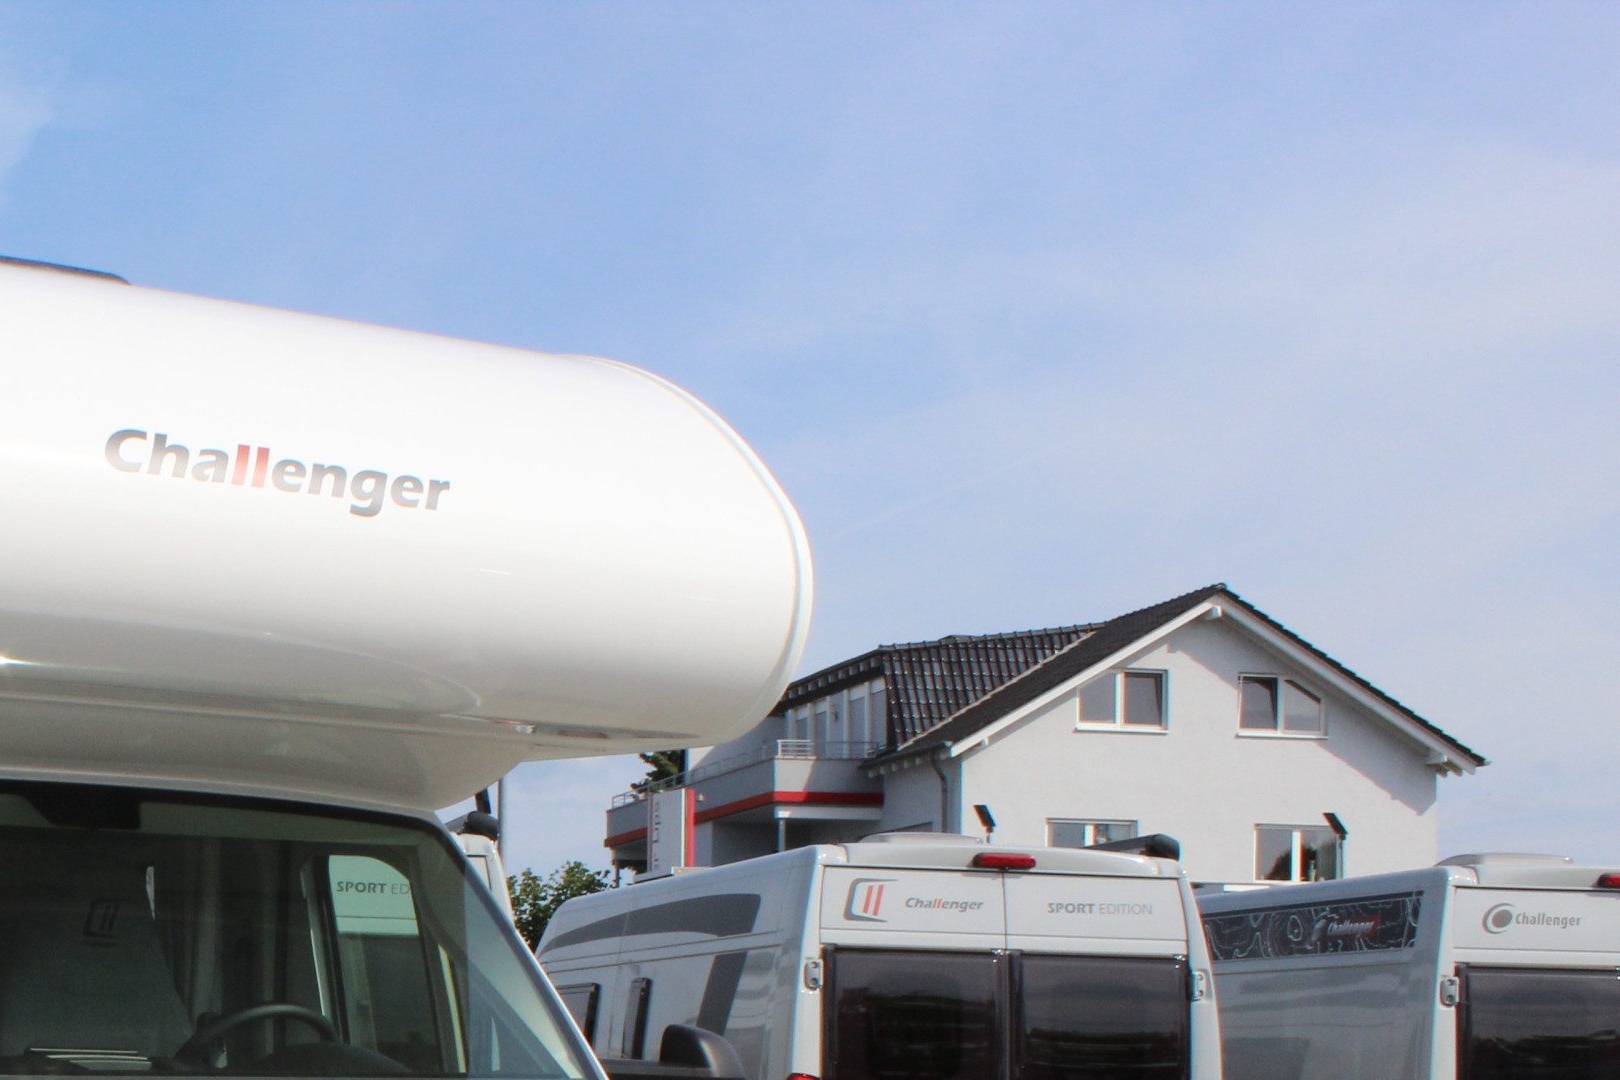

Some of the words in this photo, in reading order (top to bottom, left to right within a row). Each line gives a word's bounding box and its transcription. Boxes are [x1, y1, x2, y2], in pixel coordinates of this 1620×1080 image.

[103, 427, 451, 518] Challenger
[336, 880, 387, 894] SPORT
[905, 896, 984, 913] Challenger
[1047, 901, 1096, 915] SPORT
[1098, 902, 1153, 916] EDITION
[1515, 911, 1582, 929] Challenger
